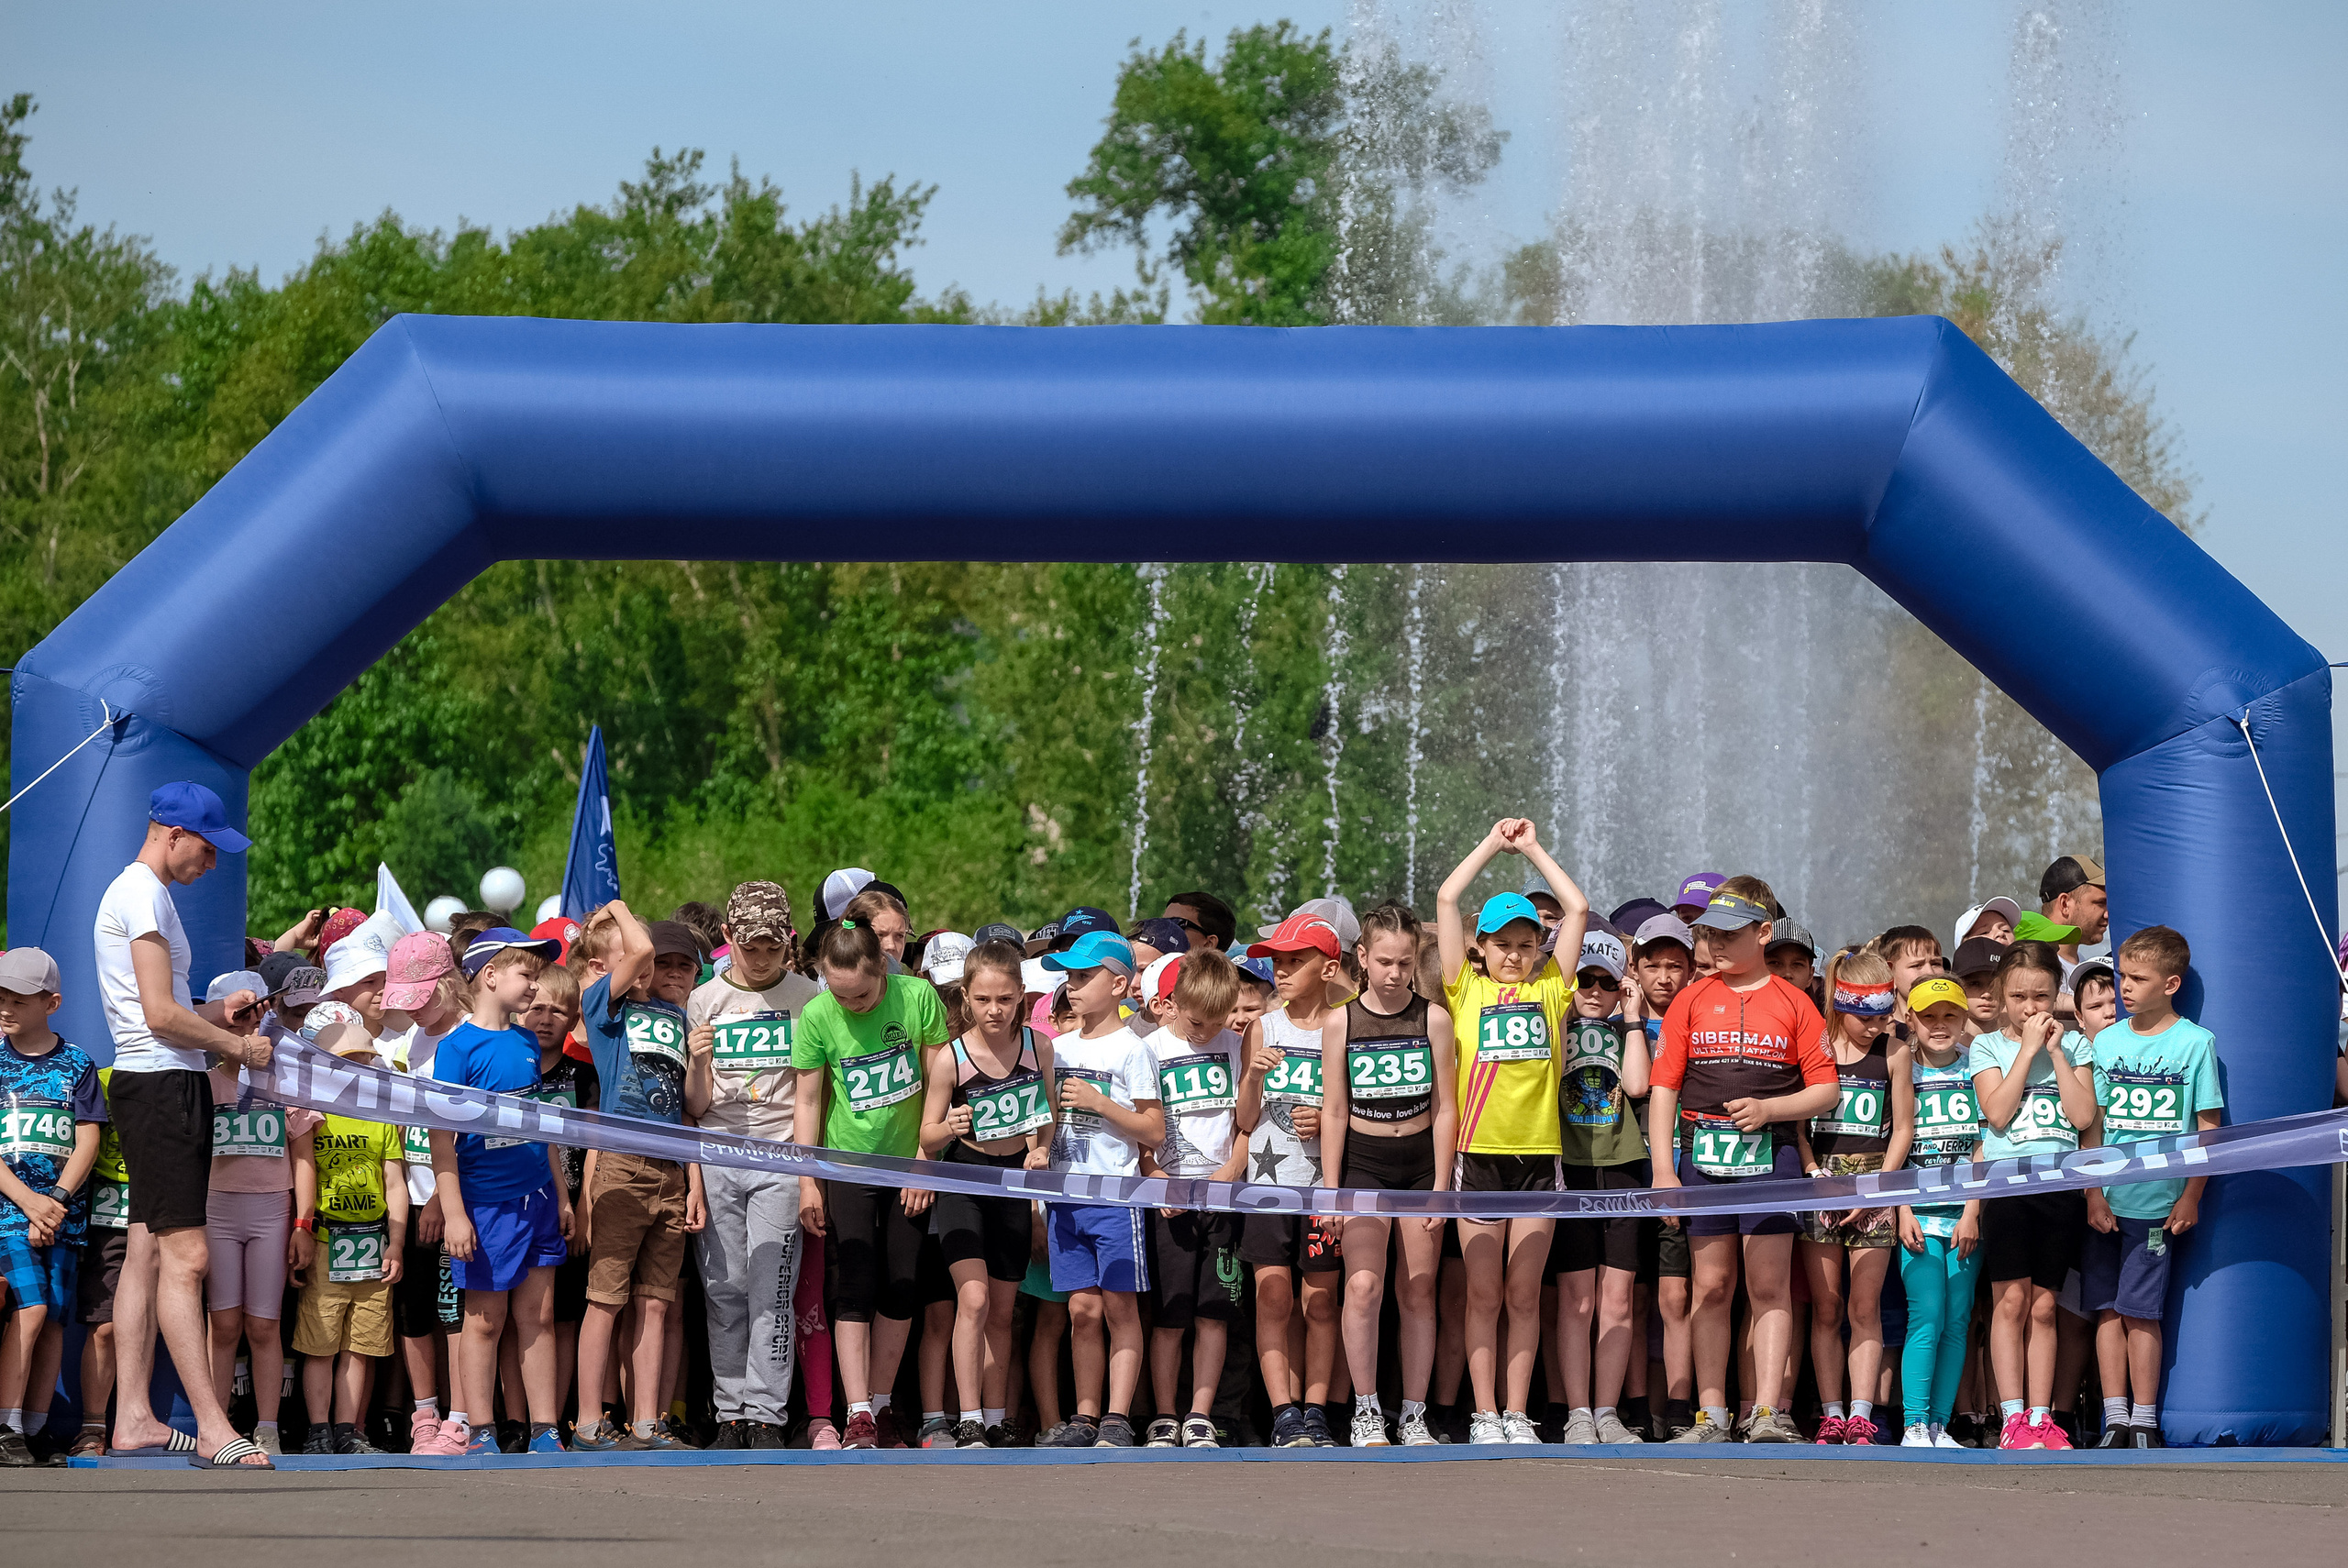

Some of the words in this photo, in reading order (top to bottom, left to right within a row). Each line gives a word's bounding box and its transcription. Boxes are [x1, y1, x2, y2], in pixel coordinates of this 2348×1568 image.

[1580, 942, 1620, 961] SKATE
[714, 1026, 790, 1054] 1721
[1482, 1016, 1546, 1048] 189
[1567, 1028, 1620, 1061] 302
[1691, 1032, 1788, 1050] SIBERMAN
[1693, 1046, 1724, 1055] ULTRA
[1727, 1046, 1786, 1060] TRIATHLON
[847, 1055, 914, 1099] 274
[1352, 1052, 1426, 1086] 235
[1162, 1066, 1227, 1104] 119
[974, 1085, 1038, 1128] 297
[1352, 1103, 1367, 1115] love
[1366, 1108, 1373, 1117] is
[1373, 1110, 1392, 1119] love
[1396, 1108, 1413, 1119] love
[1413, 1105, 1420, 1114] is
[1419, 1099, 1430, 1110] lov
[1822, 1090, 1877, 1123] 70
[2109, 1086, 2176, 1118] 292
[1, 1112, 72, 1141] 1746
[213, 1112, 280, 1143] 310
[315, 1134, 370, 1151] START
[1697, 1133, 1763, 1164] 177
[1922, 1143, 1937, 1151] AND
[1938, 1140, 1974, 1154] JERRY
[328, 1194, 377, 1211] GAME
[775, 1233, 796, 1310] SUPERIOR
[771, 1314, 790, 1364] SPORT
